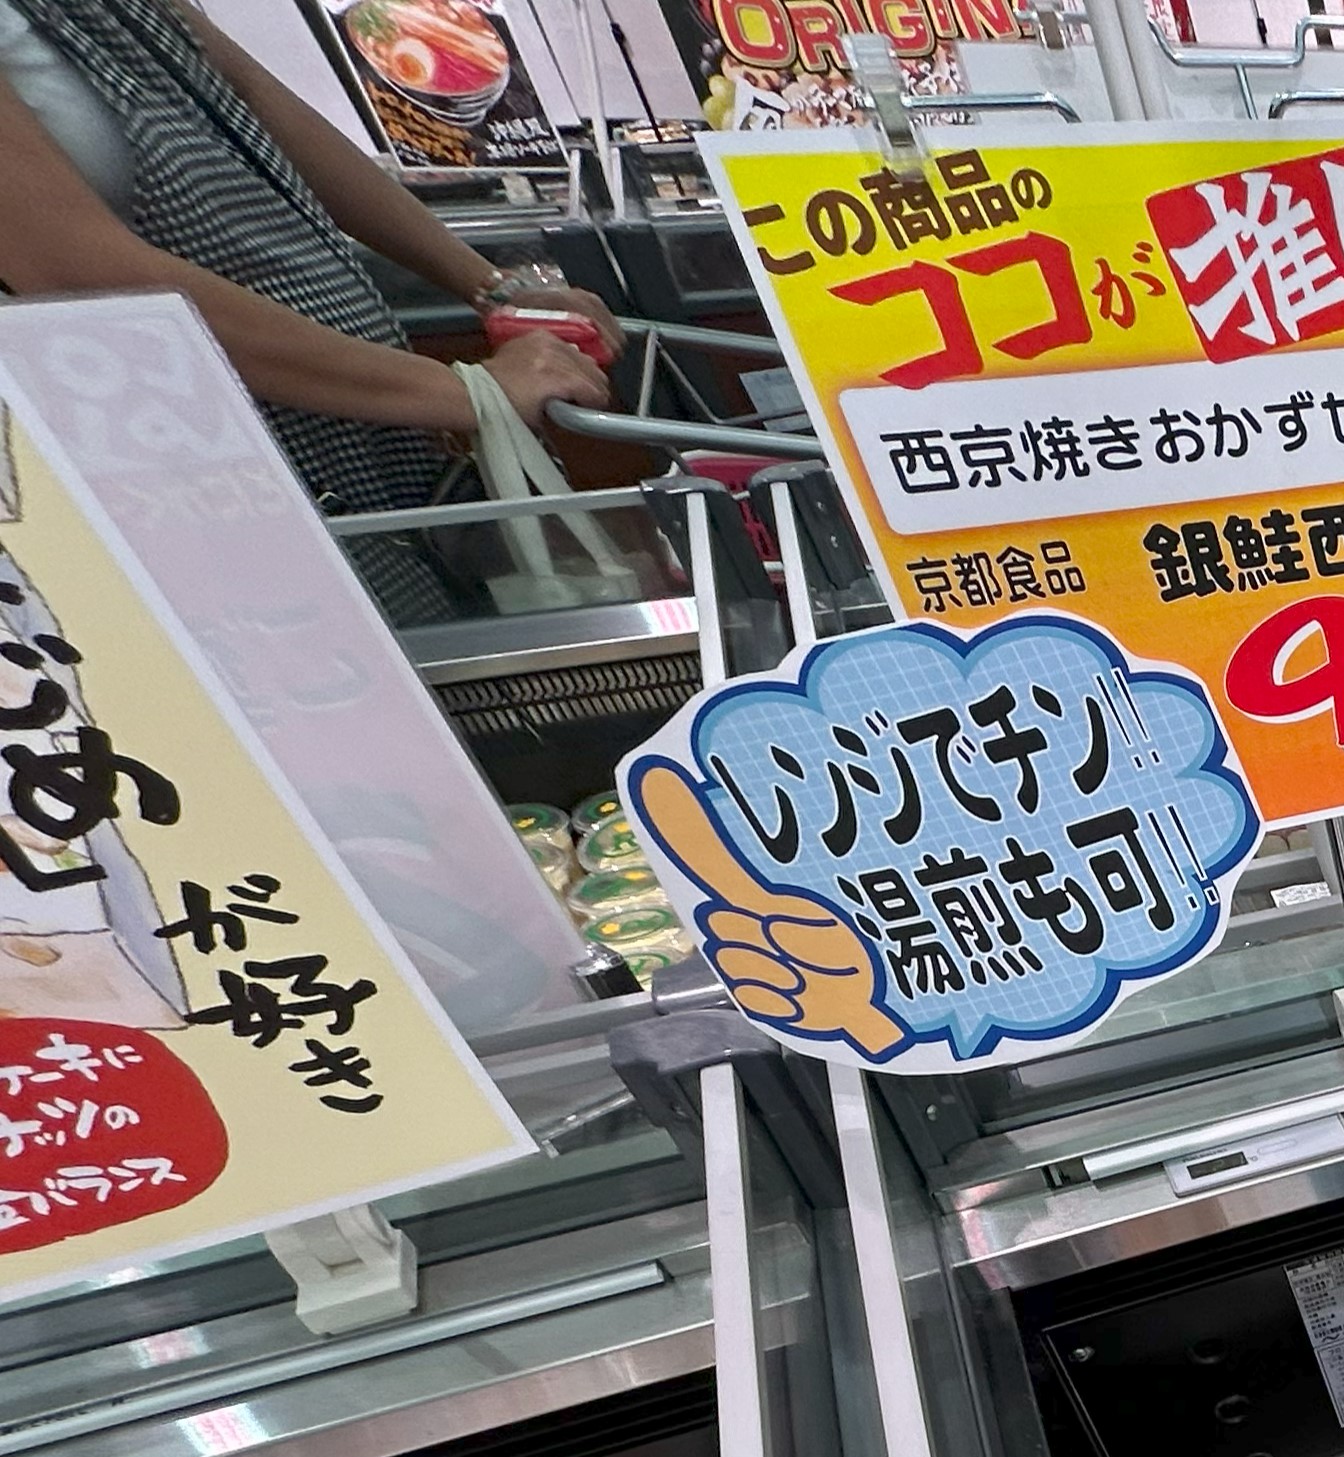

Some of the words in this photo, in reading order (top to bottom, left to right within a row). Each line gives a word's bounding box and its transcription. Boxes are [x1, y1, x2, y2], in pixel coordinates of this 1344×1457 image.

[745, 150, 1051, 275] この商品の
[907, 541, 1088, 613] 京都食品
